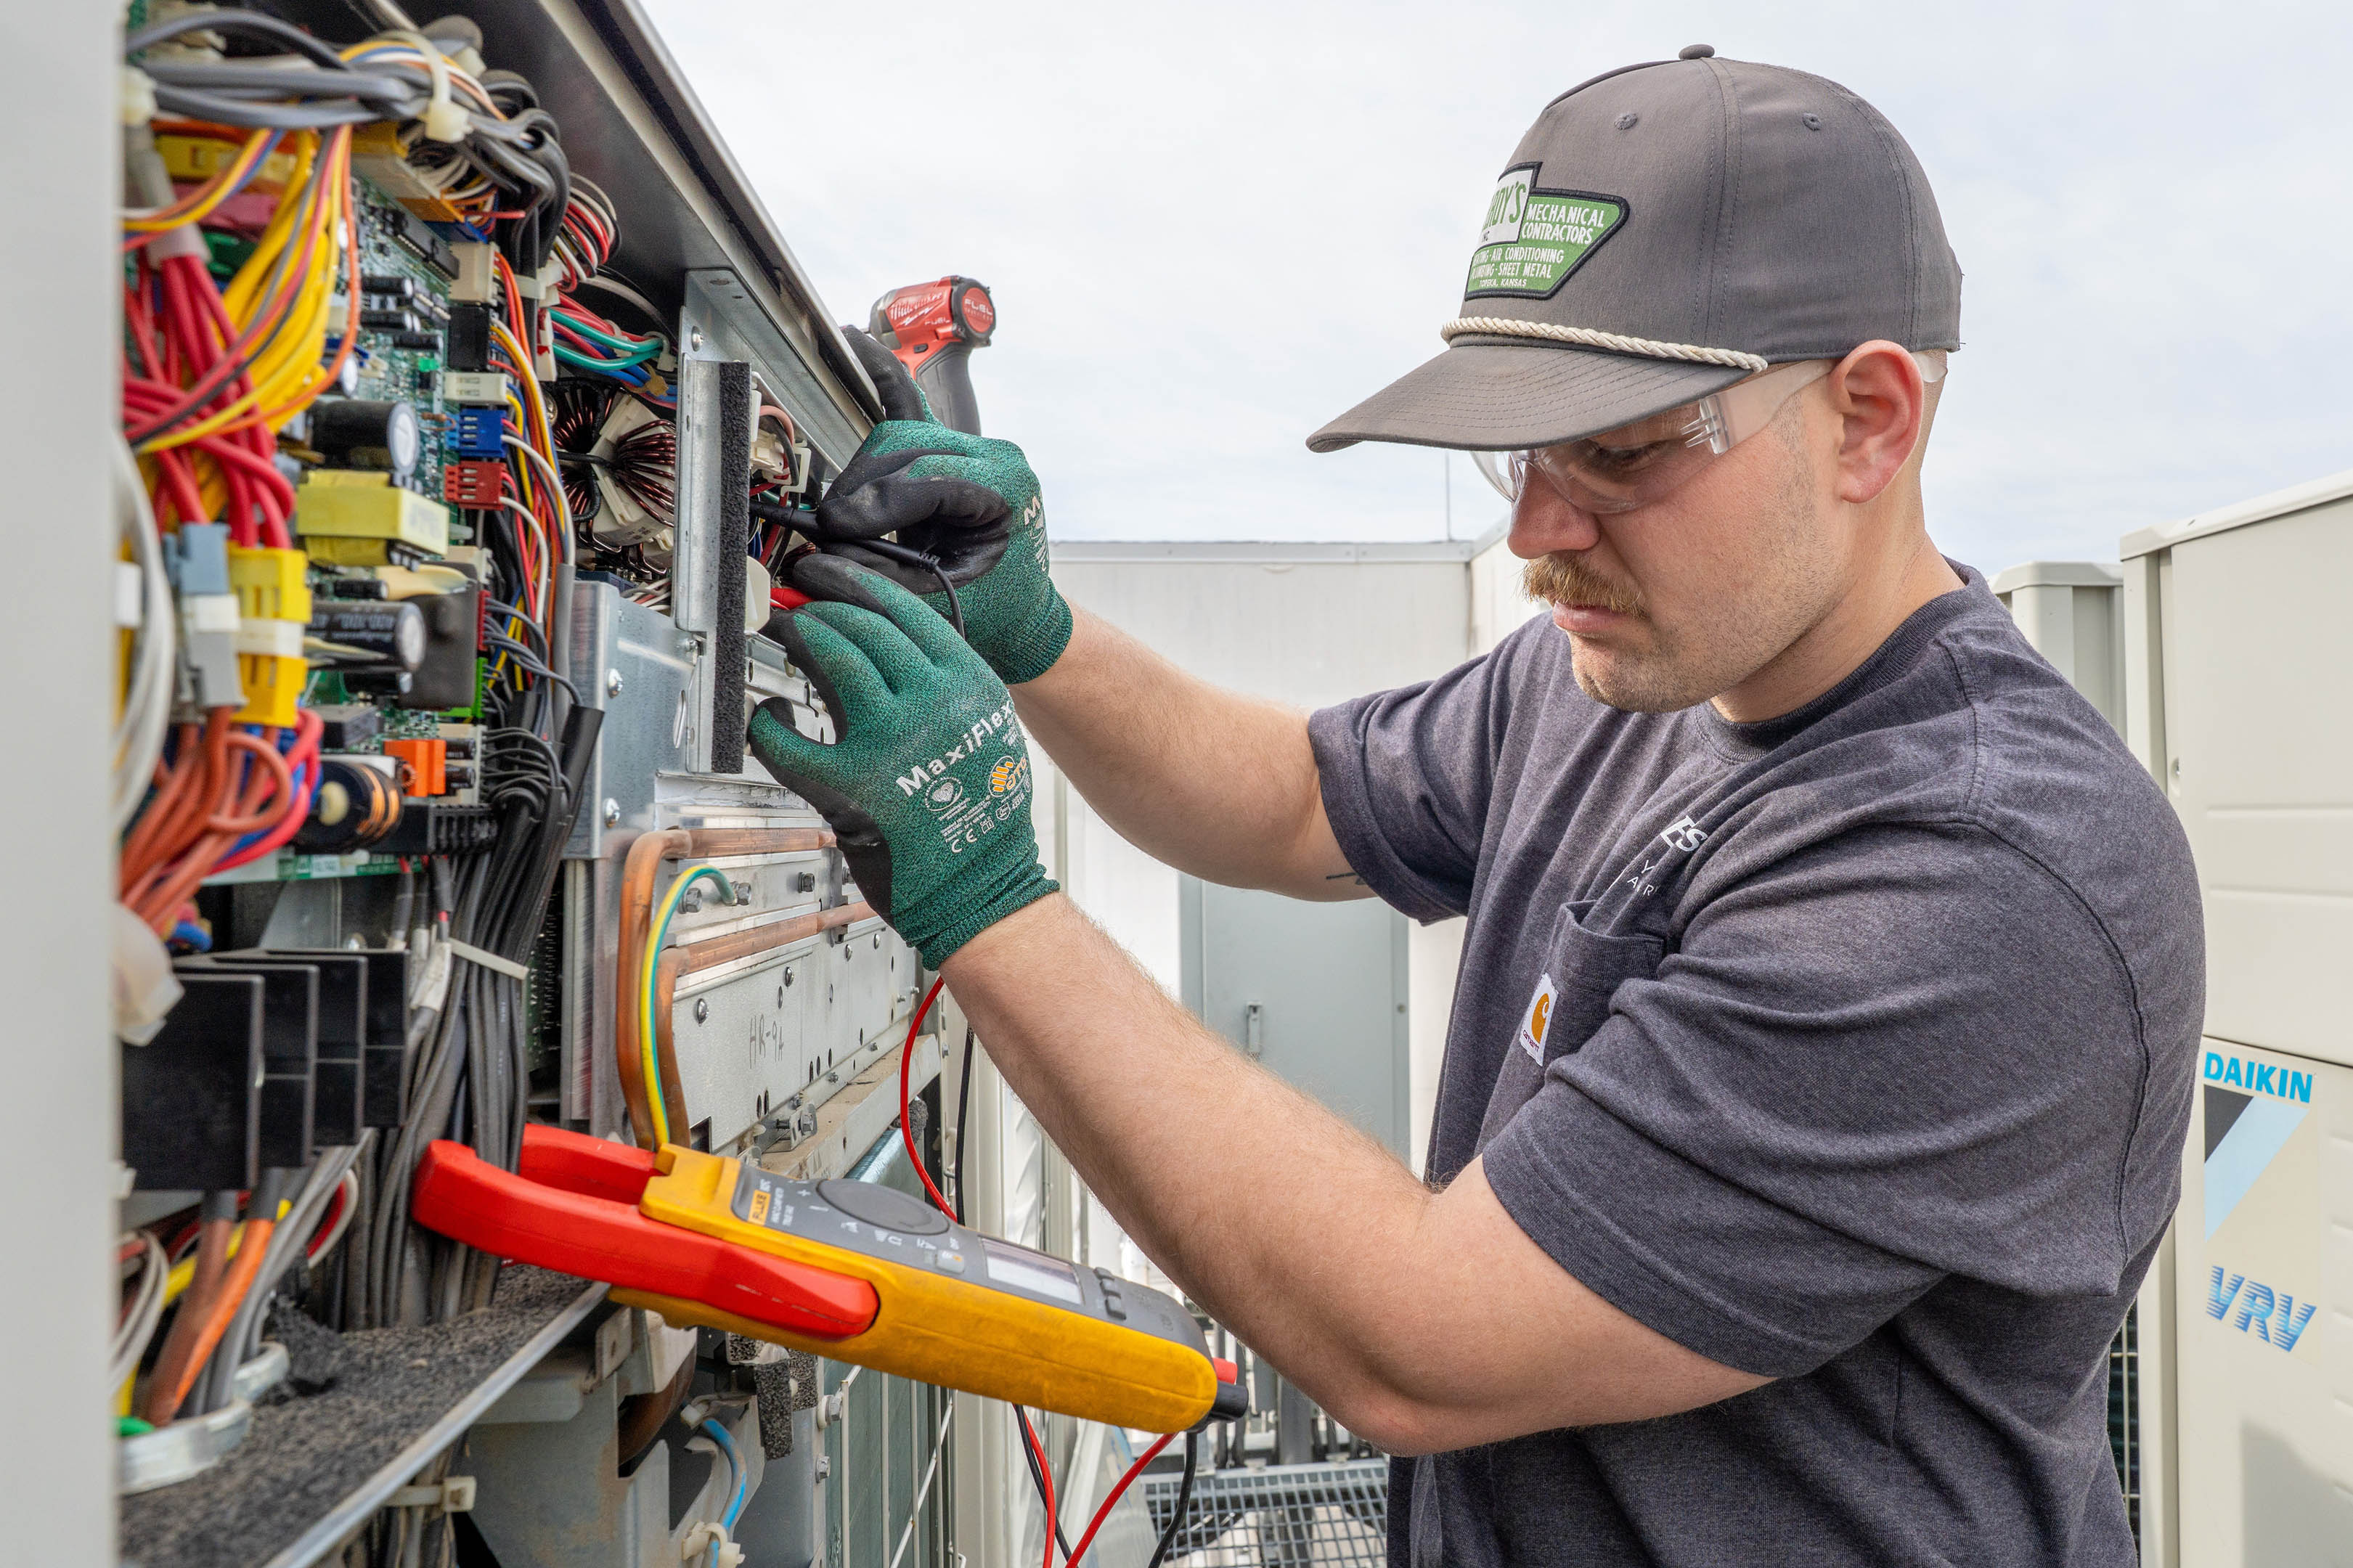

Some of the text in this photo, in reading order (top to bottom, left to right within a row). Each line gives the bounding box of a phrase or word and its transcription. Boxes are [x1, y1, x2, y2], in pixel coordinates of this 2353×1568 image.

[1526, 203, 1604, 228] MECHANICAL
[1521, 222, 1594, 245] CONTRACTORS
[1490, 248, 1503, 261] AIR
[1505, 246, 1565, 264] CONDITIONING
[1498, 262, 1521, 276] SHEET
[1522, 262, 1552, 279] METAL
[1501, 278, 1527, 287] KANSAS
[964, 298, 993, 316] FUEL
[924, 317, 951, 326] FUEL
[895, 701, 1014, 797] MaxiFlex
[2203, 1051, 2314, 1104] DAIKIN
[2205, 1265, 2317, 1352] VRV
